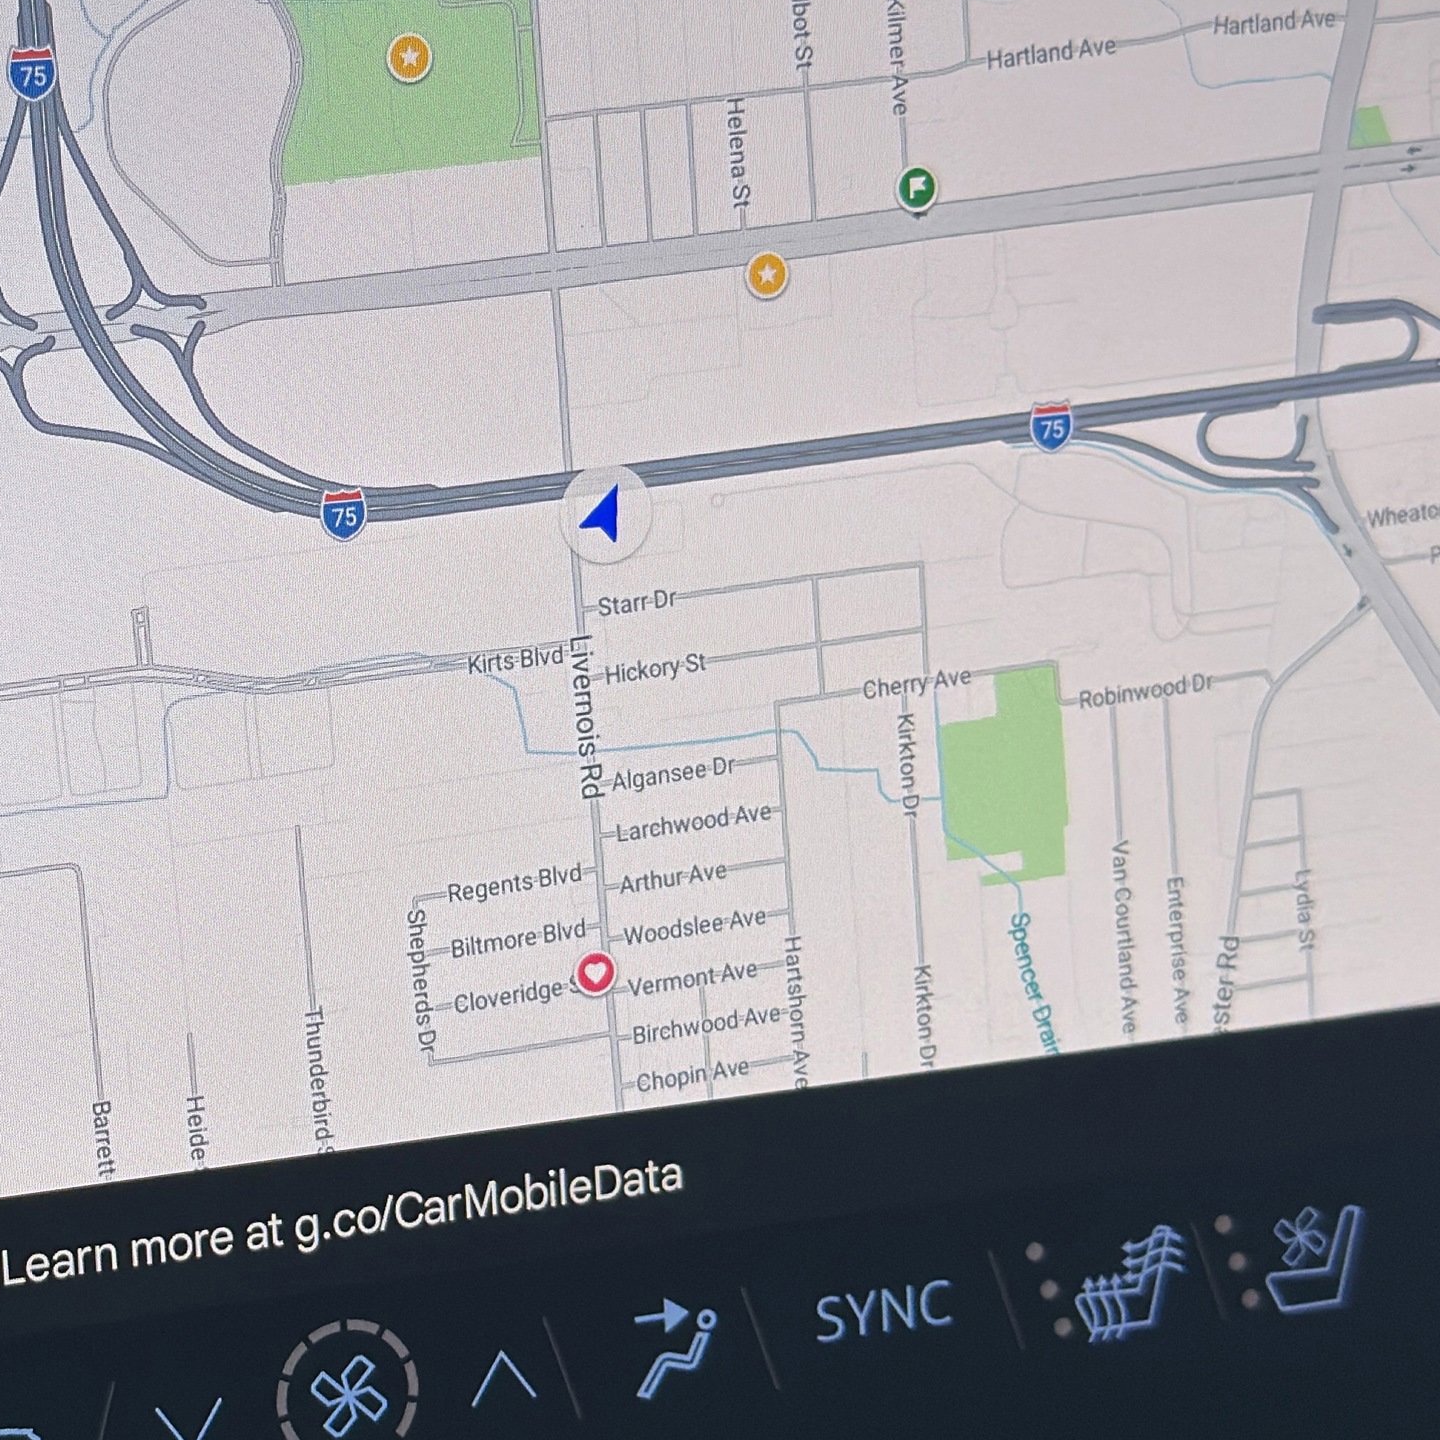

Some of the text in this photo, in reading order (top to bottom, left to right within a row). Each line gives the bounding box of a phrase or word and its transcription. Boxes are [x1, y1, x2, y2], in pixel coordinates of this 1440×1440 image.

[1212, 9, 1336, 36] Hartland Ave
[987, 36, 1117, 71] Hartland Ave
[21, 66, 47, 87] 75
[891, 74, 908, 116] Ave
[1039, 418, 1065, 440] 75
[331, 506, 358, 528] 75
[598, 589, 677, 616] Starr Dr
[468, 645, 564, 674] Kirts Blvd
[604, 653, 708, 687] Hickory St
[862, 668, 972, 701] Cherry Ave
[1079, 673, 1214, 710] Robinwood Dr
[570, 635, 603, 799] Livernois Rd
[611, 756, 736, 791] Algansee Dr
[898, 713, 920, 818] Kirkton Dr
[616, 803, 772, 842] Larchwood Ave
[447, 865, 582, 904] Regents Blvd
[619, 862, 728, 894] Arthur Ave
[451, 920, 587, 958] Biltmore Blvd
[623, 909, 767, 946] Woodslee Ave
[1111, 840, 1137, 1034] Van Courtland Ave
[1166, 876, 1188, 1023] Enterprise Ave
[407, 908, 436, 1054] Shepherds Dr
[453, 979, 563, 1014] Cloveridge
[628, 961, 758, 996] Vermont Ave
[632, 1006, 781, 1045] Birchwood Ave
[784, 935, 810, 1090] Hartshorn Ave
[304, 1006, 333, 1139] Thunderbird
[636, 1058, 750, 1094] Chopin Ave
[91, 1101, 116, 1179] Barrett
[0, 1241, 118, 1287] Learn
[129, 1223, 235, 1268] more
[245, 1214, 284, 1251] at
[294, 1158, 685, 1253] g.co/CarMobileData
[814, 1279, 955, 1343] SYNC
